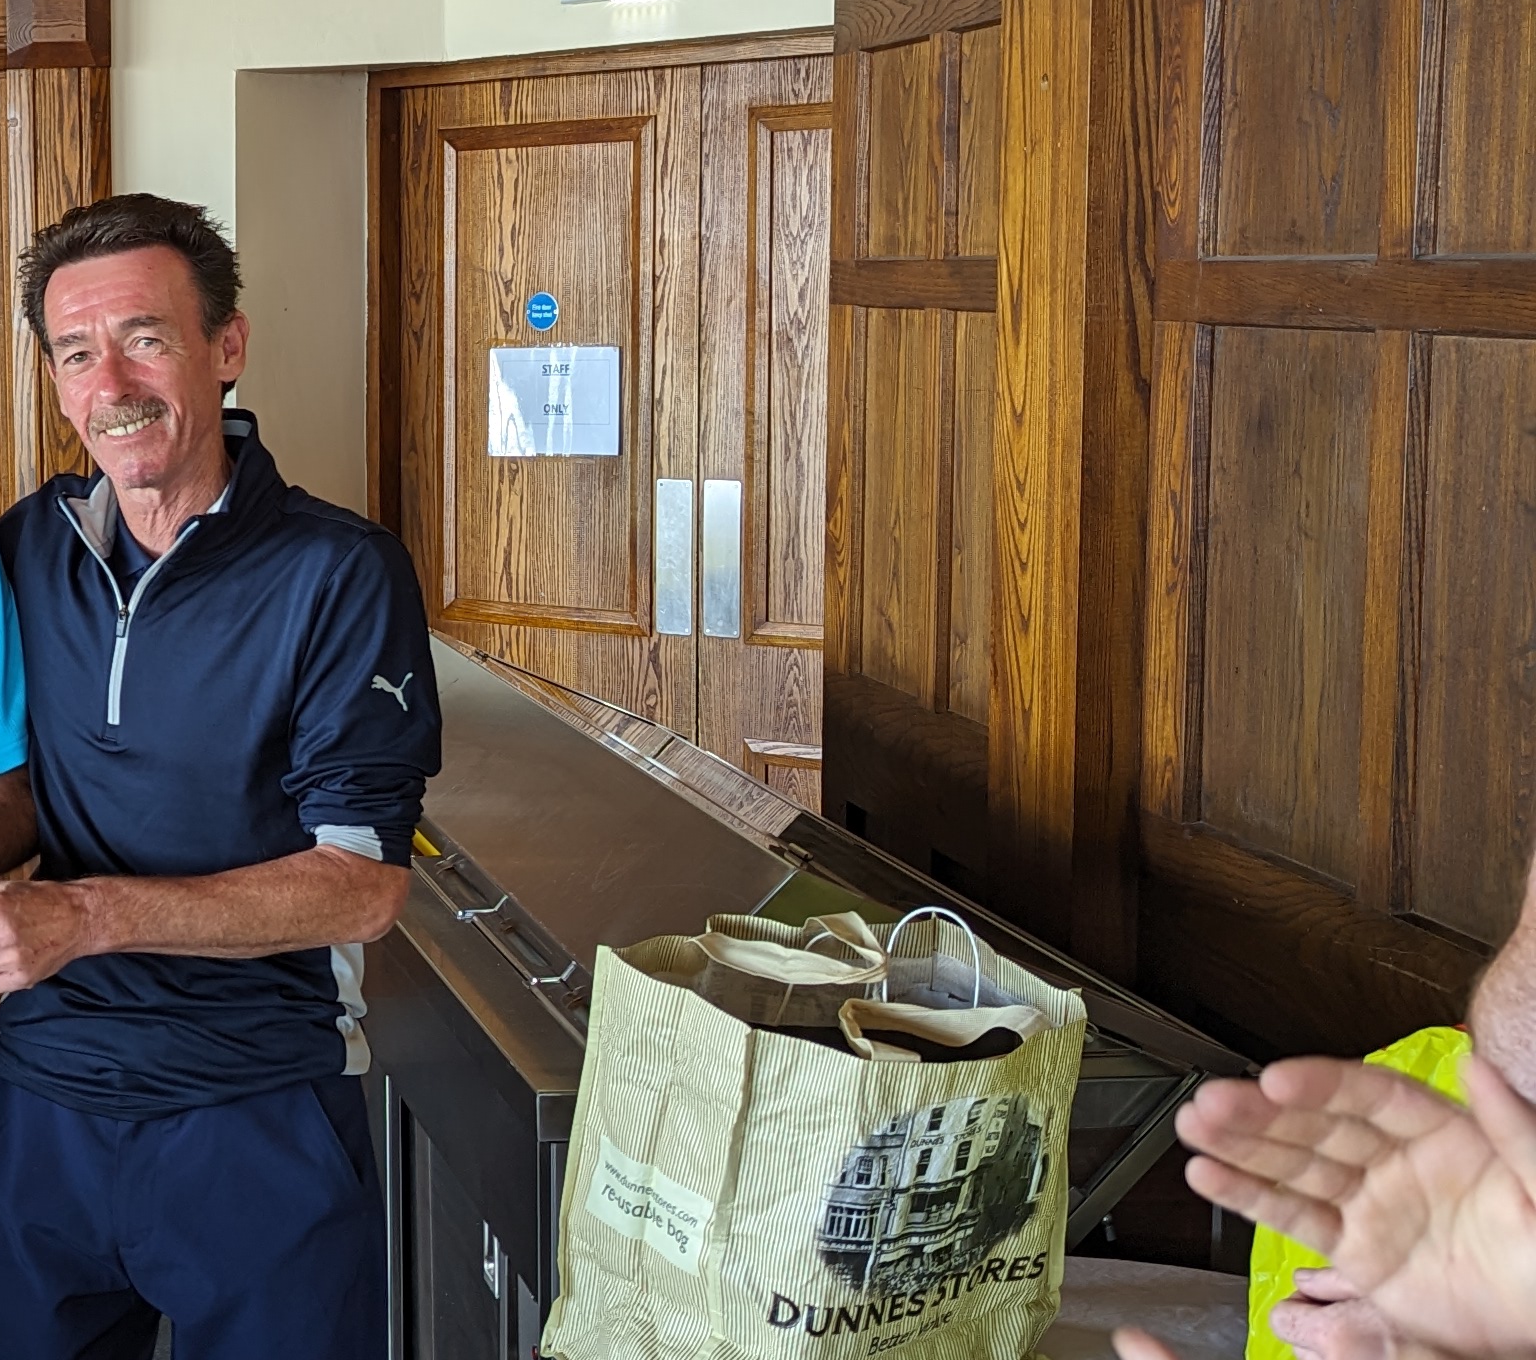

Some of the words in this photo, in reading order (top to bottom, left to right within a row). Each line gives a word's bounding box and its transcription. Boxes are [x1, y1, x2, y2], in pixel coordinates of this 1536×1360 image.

[542, 364, 570, 375] STAFF
[543, 403, 569, 414] ONLY
[601, 1183, 664, 1228] re-usable
[667, 1218, 689, 1254] bag
[767, 1289, 929, 1338] DUNNES
[932, 1252, 1047, 1307] STORES
[868, 1328, 915, 1356] Better
